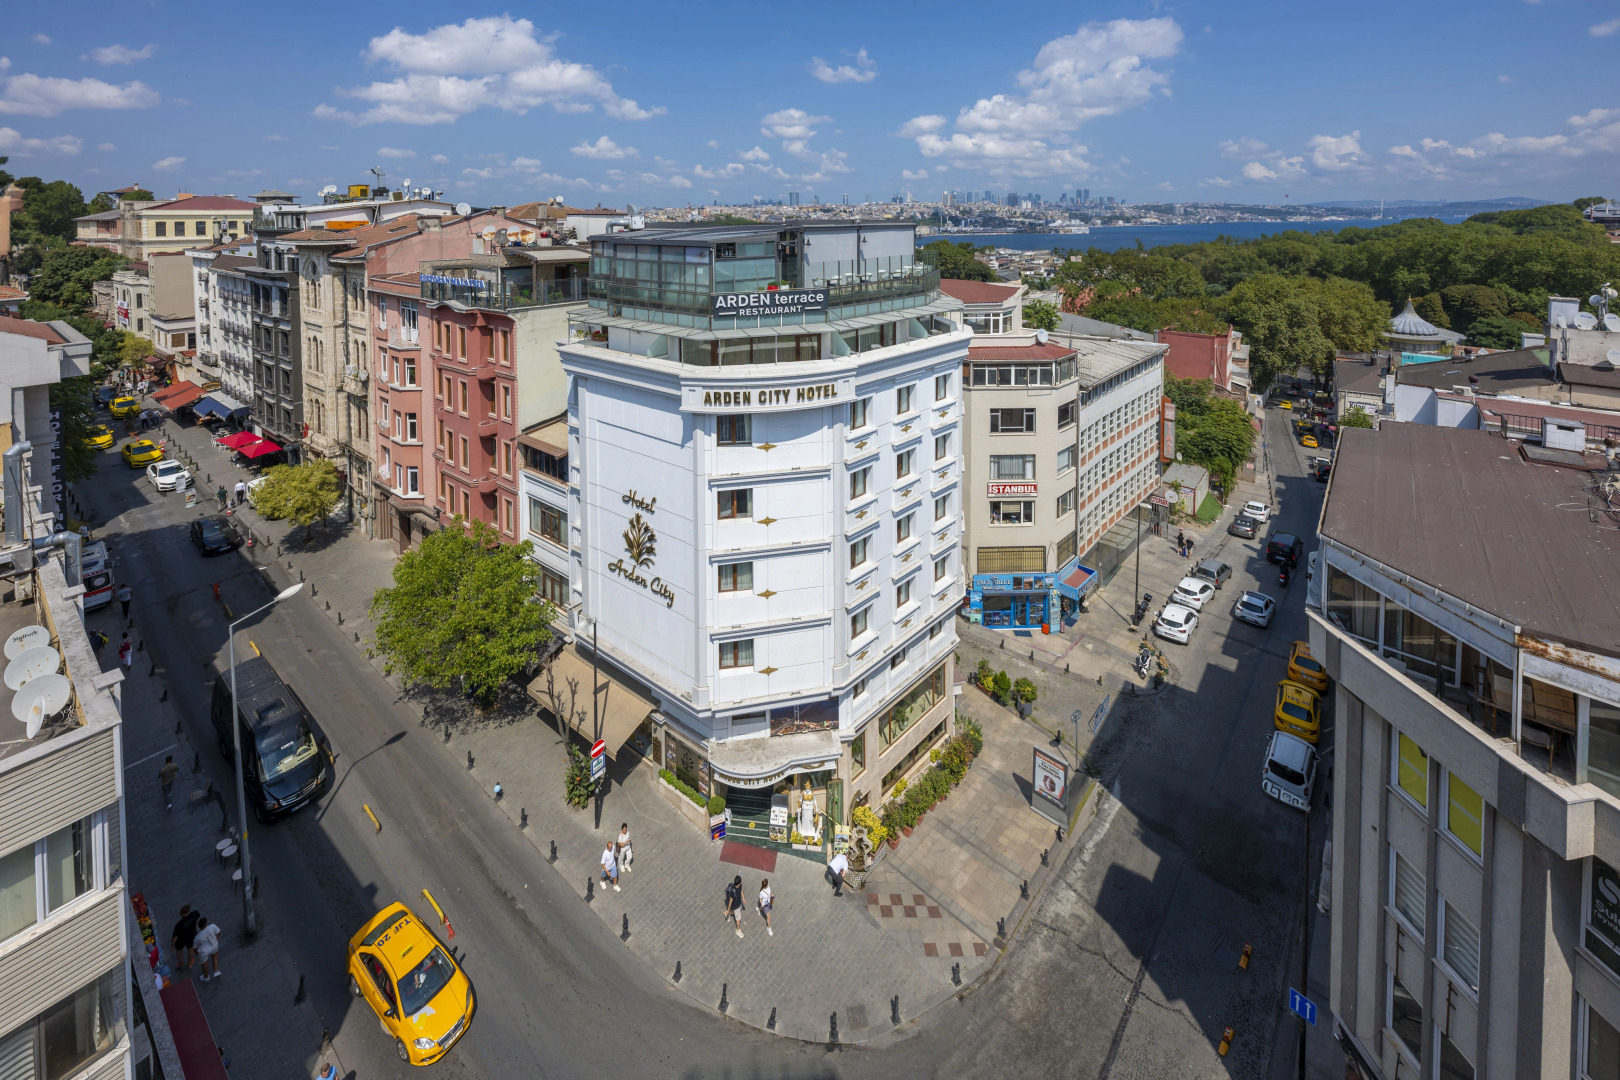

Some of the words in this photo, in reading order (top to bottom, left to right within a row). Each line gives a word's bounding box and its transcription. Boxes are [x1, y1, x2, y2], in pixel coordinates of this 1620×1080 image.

[715, 293, 770, 309] ARDEN
[774, 293, 825, 305] terrace
[739, 305, 803, 316] RESTAURANT
[703, 391, 751, 405] ARDEN
[758, 389, 791, 404] CITY
[796, 383, 838, 401] HOTEL
[621, 489, 657, 513] Hotel
[607, 559, 648, 588] Arden
[650, 577, 676, 608] City
[392, 918, 411, 936] TJF
[377, 933, 391, 947] 20
